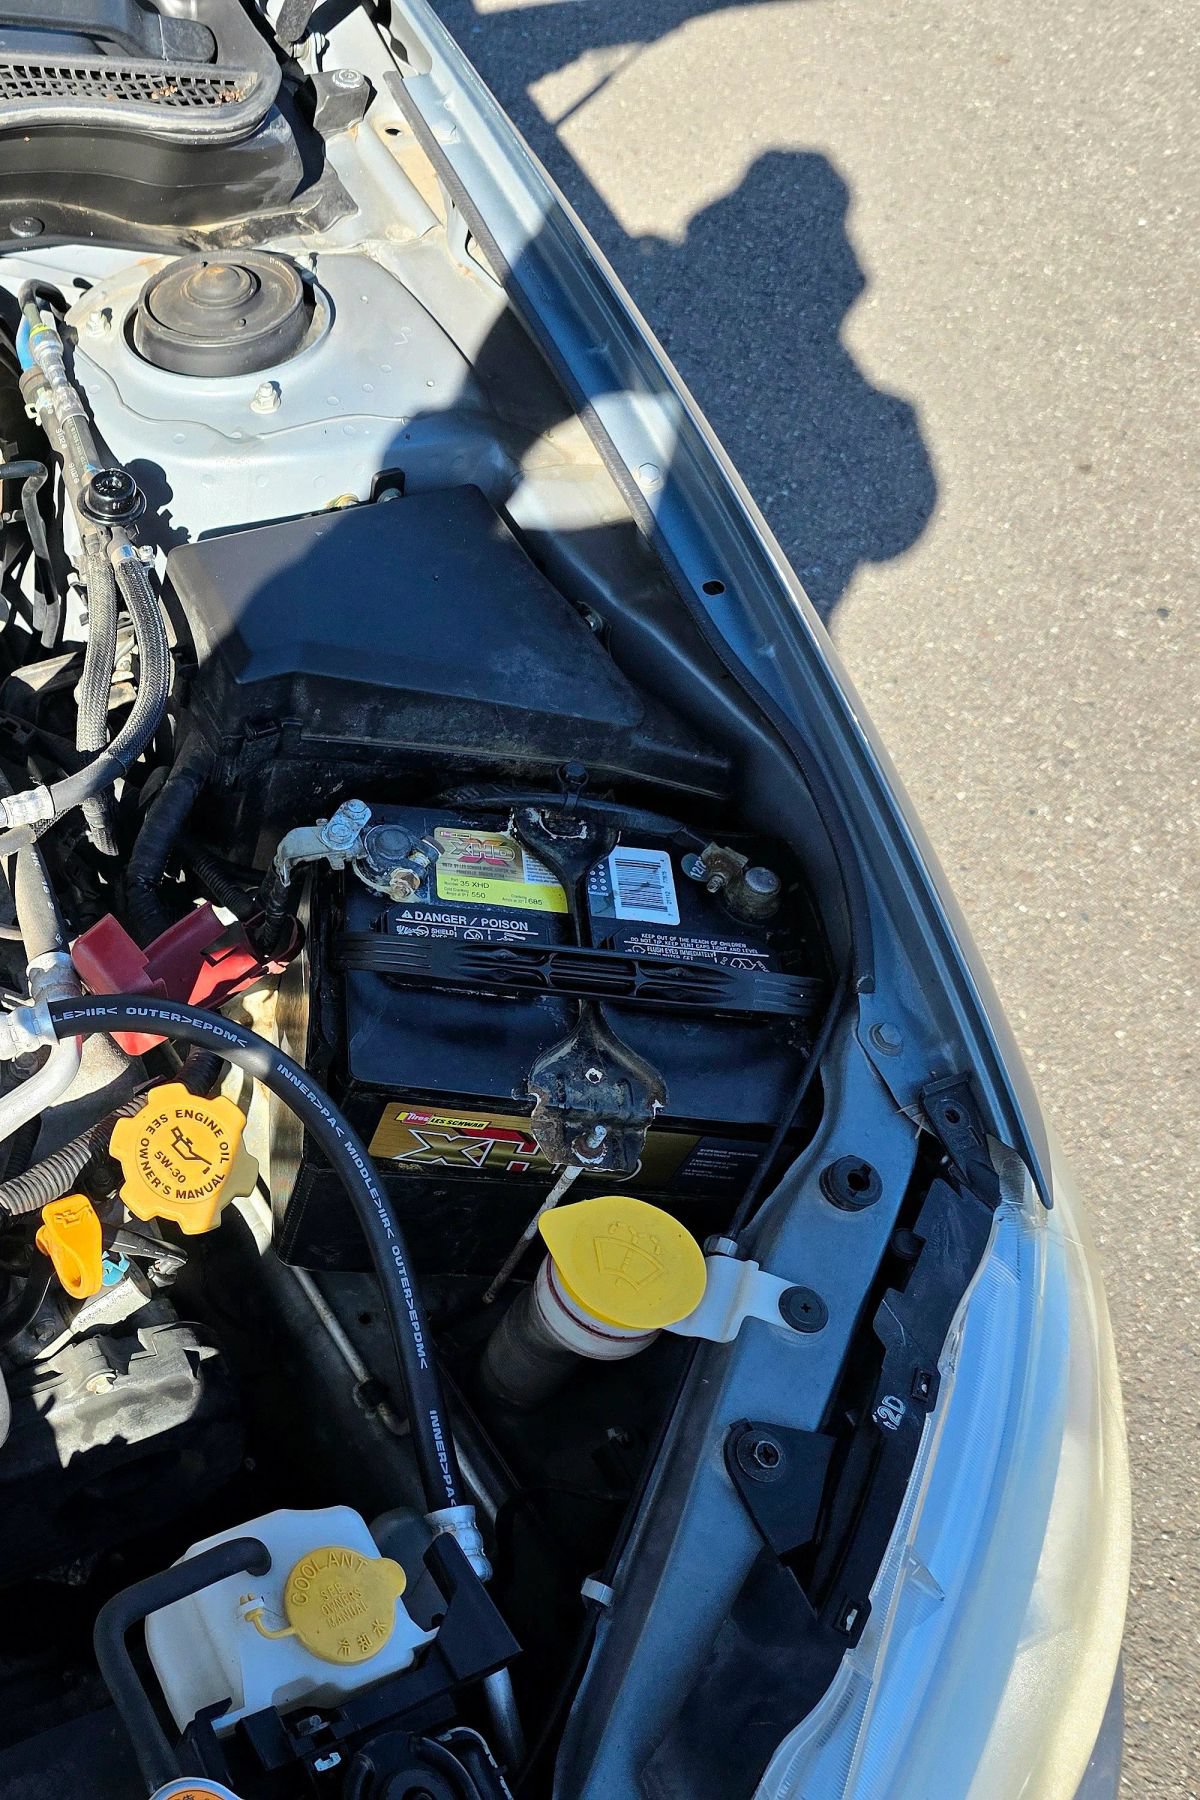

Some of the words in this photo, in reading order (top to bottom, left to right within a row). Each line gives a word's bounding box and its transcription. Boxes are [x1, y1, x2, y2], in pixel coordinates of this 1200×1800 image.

[449, 840, 516, 862] XHD
[471, 891, 486, 899] 550
[472, 881, 490, 889] XHD
[528, 898, 543, 906] 685
[414, 909, 467, 925] DANGER
[481, 919, 529, 931] POISON
[430, 927, 455, 936] SHIELD
[647, 946, 664, 954] FLUSH
[680, 949, 714, 959] IMMEDIATELY
[719, 940, 747, 949] CHILDREN
[146, 1113, 169, 1136] SEE
[407, 1111, 429, 1122] Tires
[429, 1117, 445, 1125] LES
[446, 1118, 486, 1130] SCHWAB
[175, 1109, 224, 1138] ENGINE
[219, 1141, 230, 1164] OIL
[139, 1137, 172, 1195] OWNER'S
[154, 1150, 187, 1184] 5W-30
[125, 1006, 249, 1048] OUTER>EPDM<
[276, 1063, 345, 1138] INNER>PA<
[344, 1141, 395, 1239] MIDDLE>IIR<
[391, 1245, 428, 1369] OUTER>EPDM<
[175, 1173, 225, 1200] MANUAL
[291, 1551, 369, 1606] COOLANT
[321, 1582, 343, 1601] SEE
[327, 1601, 369, 1629] MANUAL
